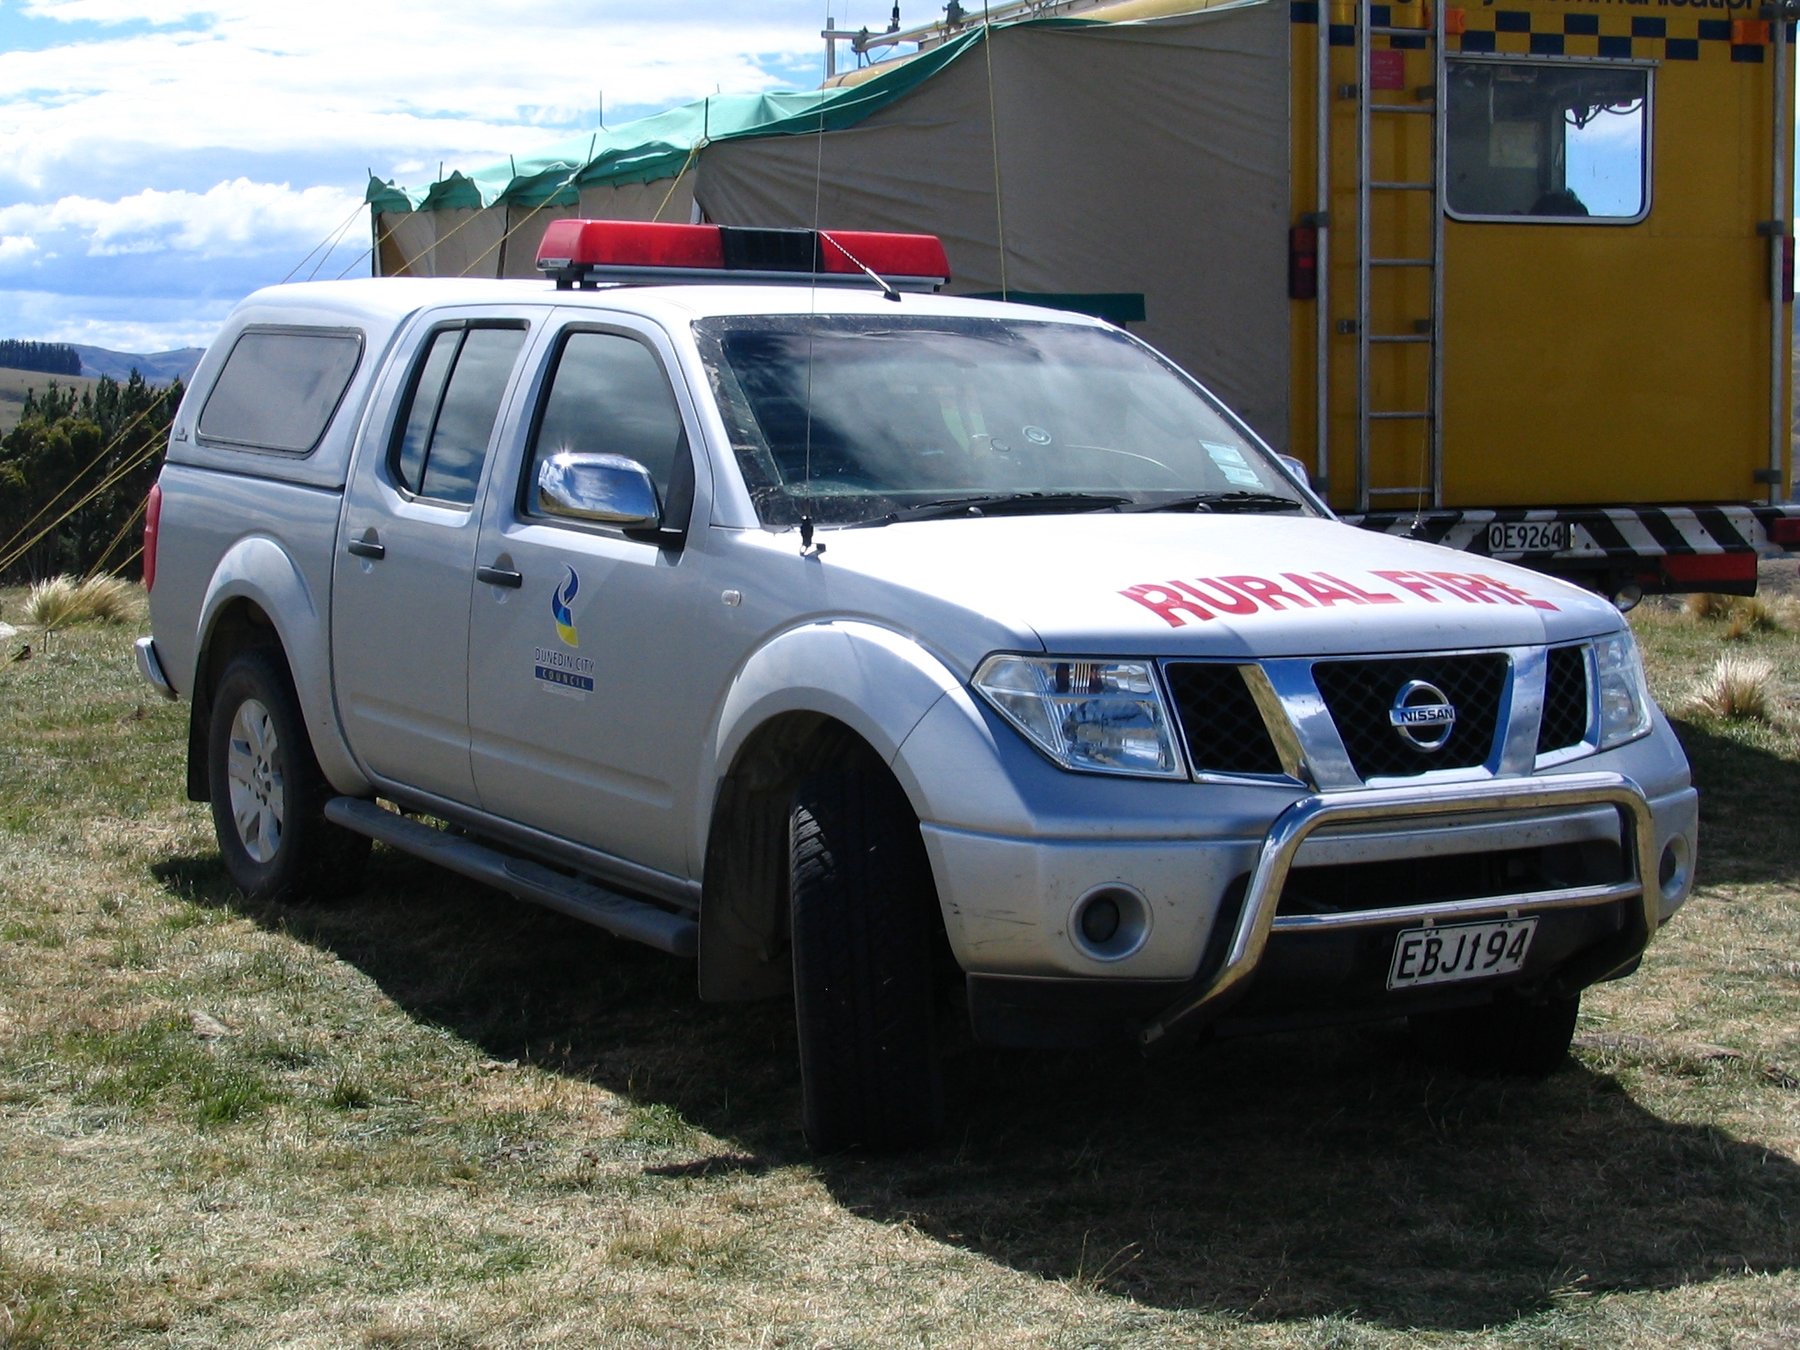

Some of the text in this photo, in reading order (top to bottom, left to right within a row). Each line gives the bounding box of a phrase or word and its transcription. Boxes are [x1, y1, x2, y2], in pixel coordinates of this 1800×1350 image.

[1491, 526, 1562, 549] OE9264
[1118, 570, 1562, 628] RURAL FIRE
[535, 648, 595, 673] DUNEDIN CITY
[542, 668, 586, 688] COUNCIL
[1400, 708, 1454, 722] NISSAN
[1397, 927, 1529, 980] EBJ194
